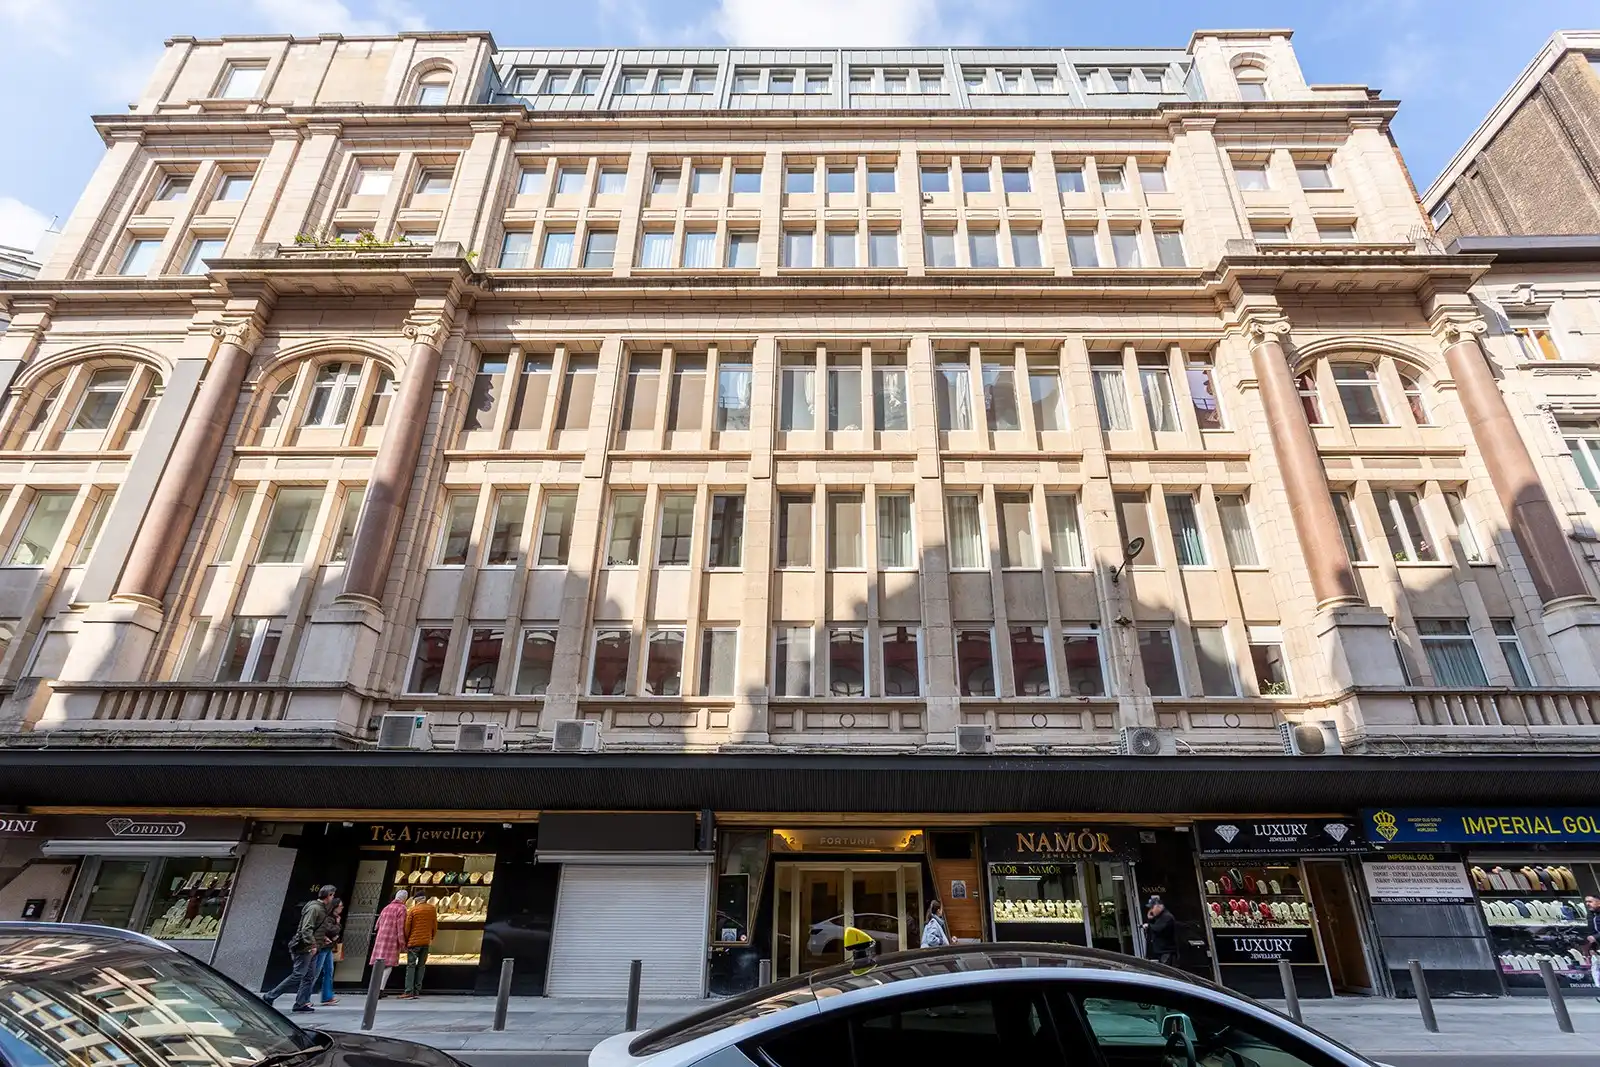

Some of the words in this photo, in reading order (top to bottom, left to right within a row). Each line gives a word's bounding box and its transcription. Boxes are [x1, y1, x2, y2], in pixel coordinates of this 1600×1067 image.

[0, 819, 38, 832] DINI
[130, 825, 181, 834] ORDINI
[1253, 823, 1308, 836] LUXURY
[1461, 816, 1561, 834] IMPERIAL
[1562, 816, 1600, 834] GOL
[371, 825, 412, 841] T&A
[414, 827, 485, 843] jewellery
[1233, 938, 1293, 952] LUXURY
